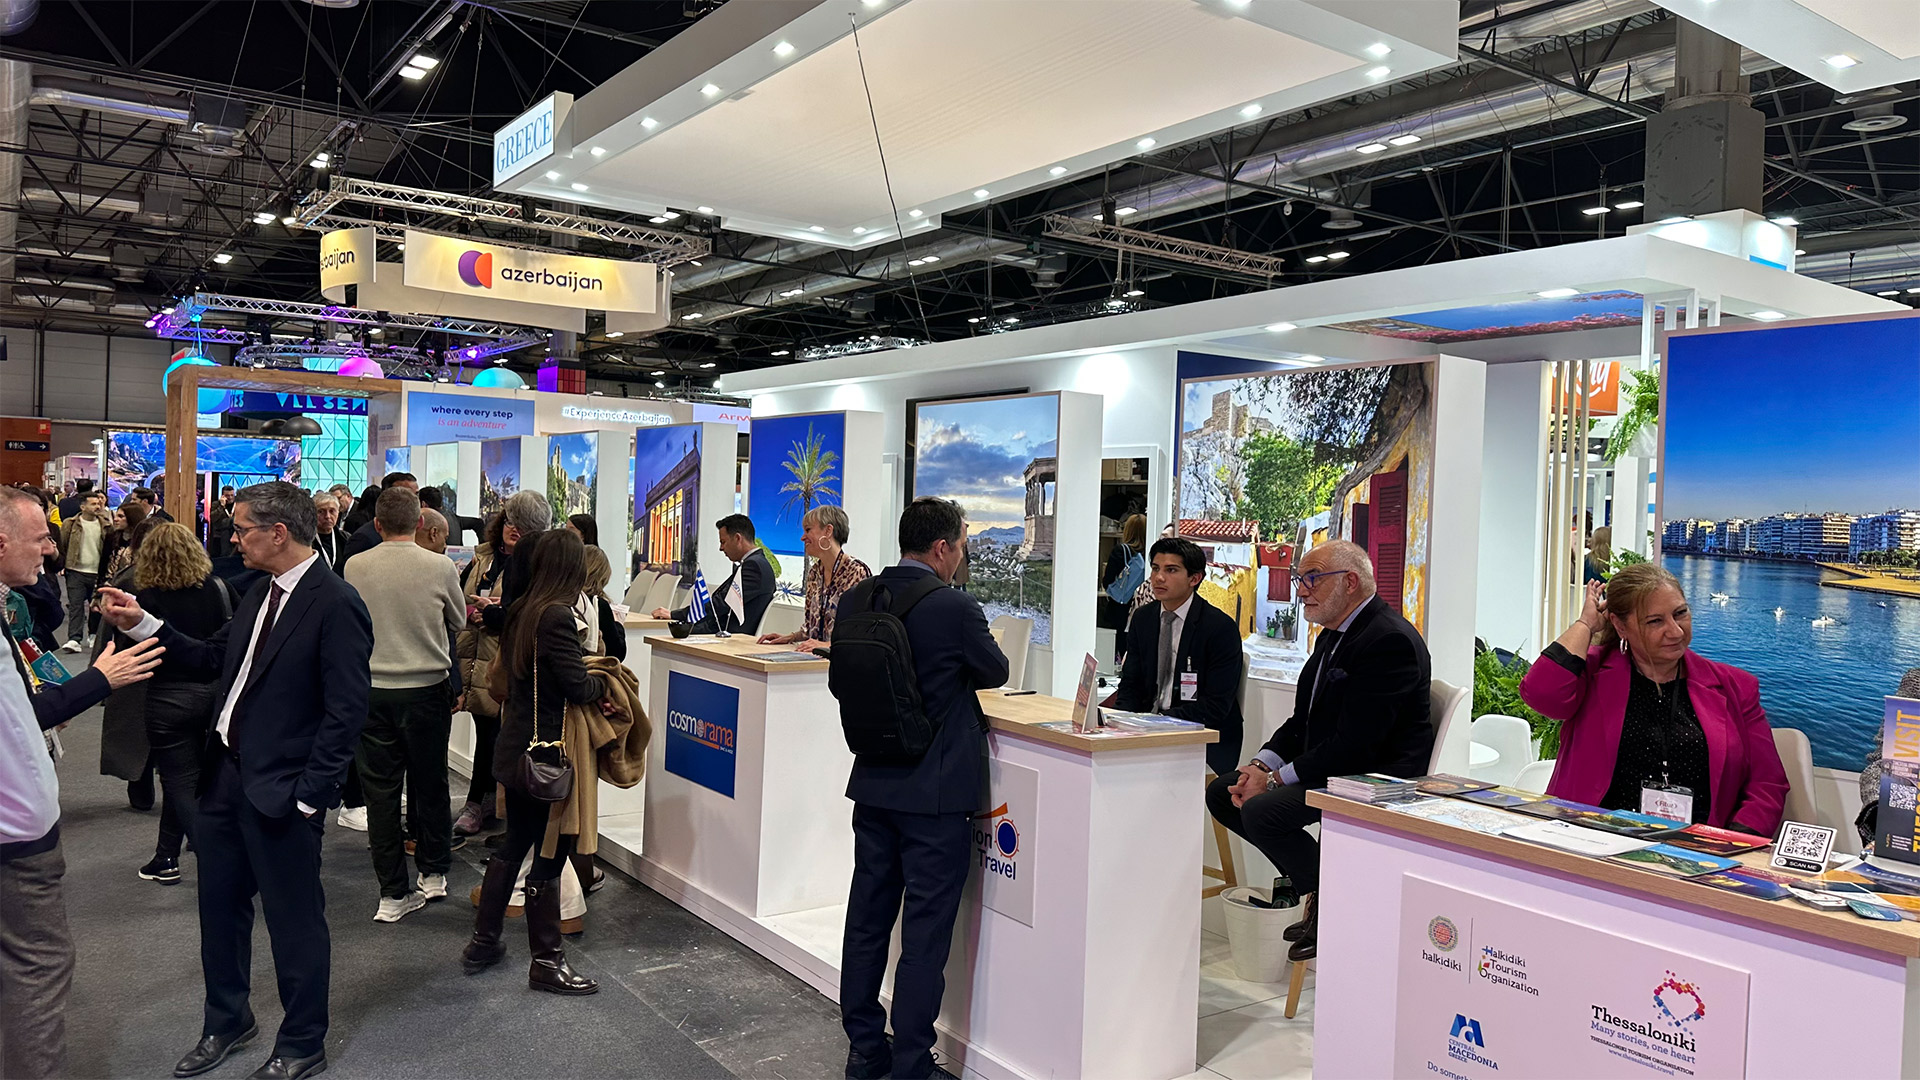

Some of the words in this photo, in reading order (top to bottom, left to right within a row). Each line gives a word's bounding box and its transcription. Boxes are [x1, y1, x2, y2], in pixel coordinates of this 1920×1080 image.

[497, 110, 552, 173] GREECE
[501, 266, 603, 292] azerbaijan
[431, 405, 461, 415] where
[464, 408, 490, 419] every
[493, 409, 513, 420] step
[438, 417, 447, 426] is
[449, 419, 460, 428] an
[461, 418, 507, 430] adventure
[564, 407, 671, 425] #ExperienceAzerbaijan
[972, 823, 993, 849] ion
[977, 848, 1016, 880] Travel
[1788, 861, 1807, 869] SCAN
[1422, 949, 1462, 972] halkidiki
[1482, 945, 1526, 967] Halkidiki
[1490, 958, 1527, 980] Tourism
[1479, 968, 1539, 996] Organization
[1591, 1004, 1696, 1053] Thessaloniki
[1448, 1038, 1477, 1054] CENTRAL
[1590, 1020, 1615, 1038] Many
[1617, 1031, 1650, 1050] stories,
[1651, 1042, 1669, 1055] one
[1670, 1046, 1696, 1065] heart
[1590, 1034, 1628, 1053] THESSALONIKI
[1627, 1048, 1652, 1061] TOURISM
[1427, 1060, 1439, 1073] Do
[1448, 1044, 1499, 1070] MACEDONIA
